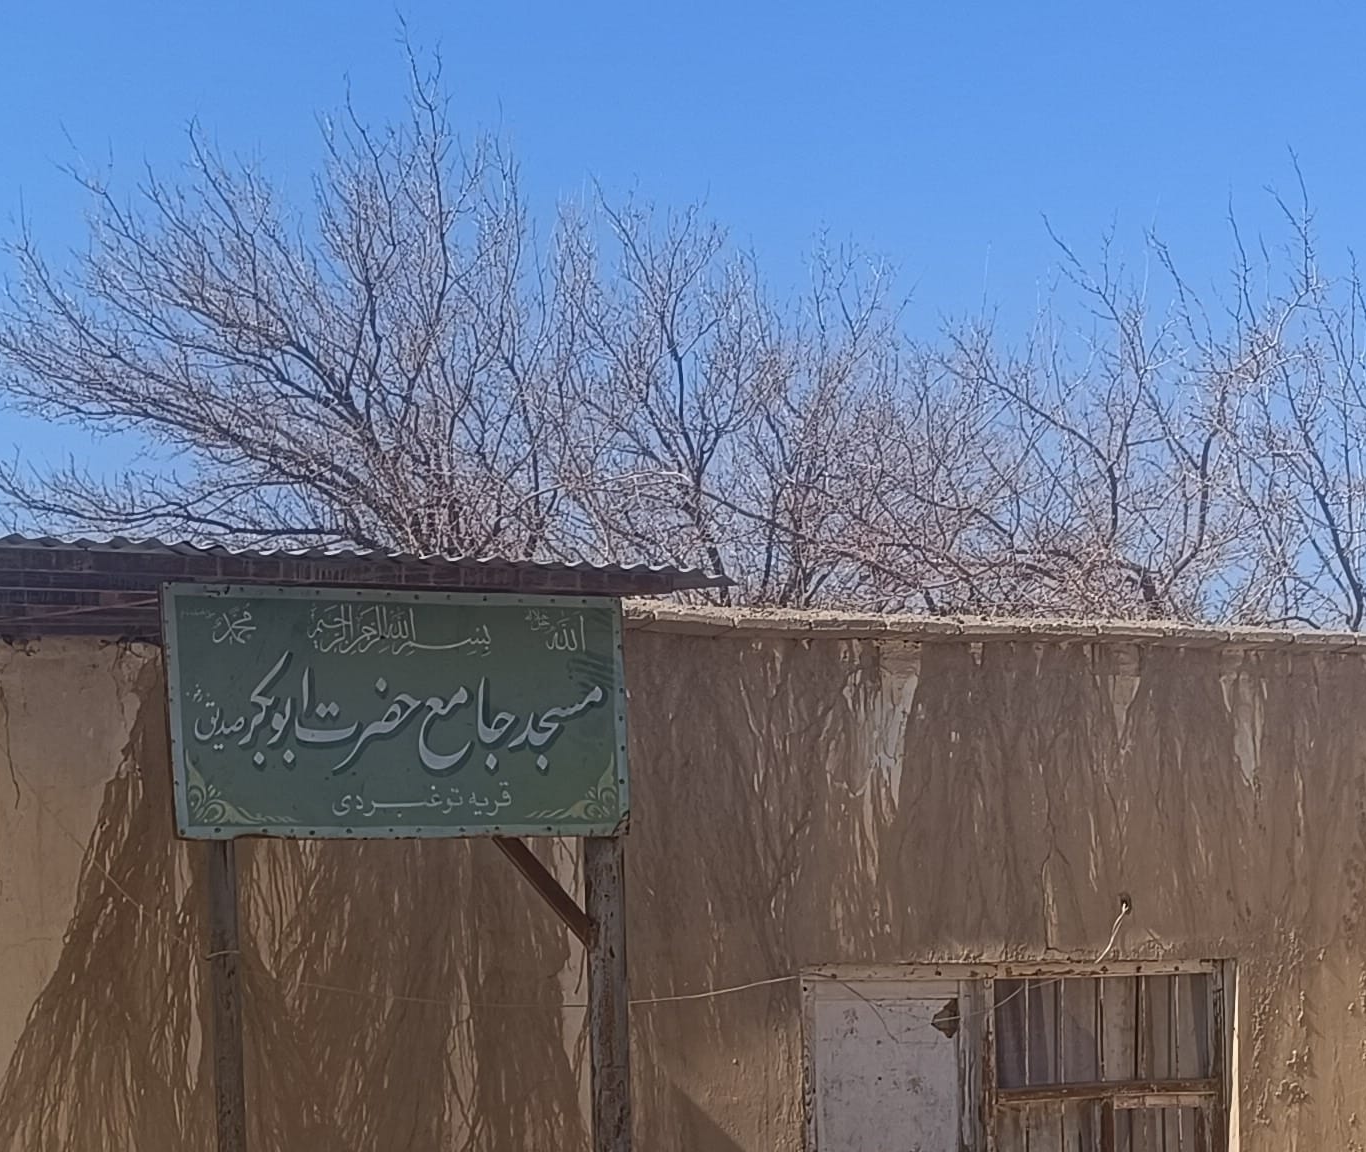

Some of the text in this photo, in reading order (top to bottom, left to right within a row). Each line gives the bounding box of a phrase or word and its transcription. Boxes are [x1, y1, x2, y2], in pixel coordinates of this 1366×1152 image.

[212, 602, 257, 645] محمد
[545, 612, 585, 652] الله
[194, 651, 603, 770] مسجد جامع حضرت ابوبکر صدیق
[468, 781, 512, 816] قریه
